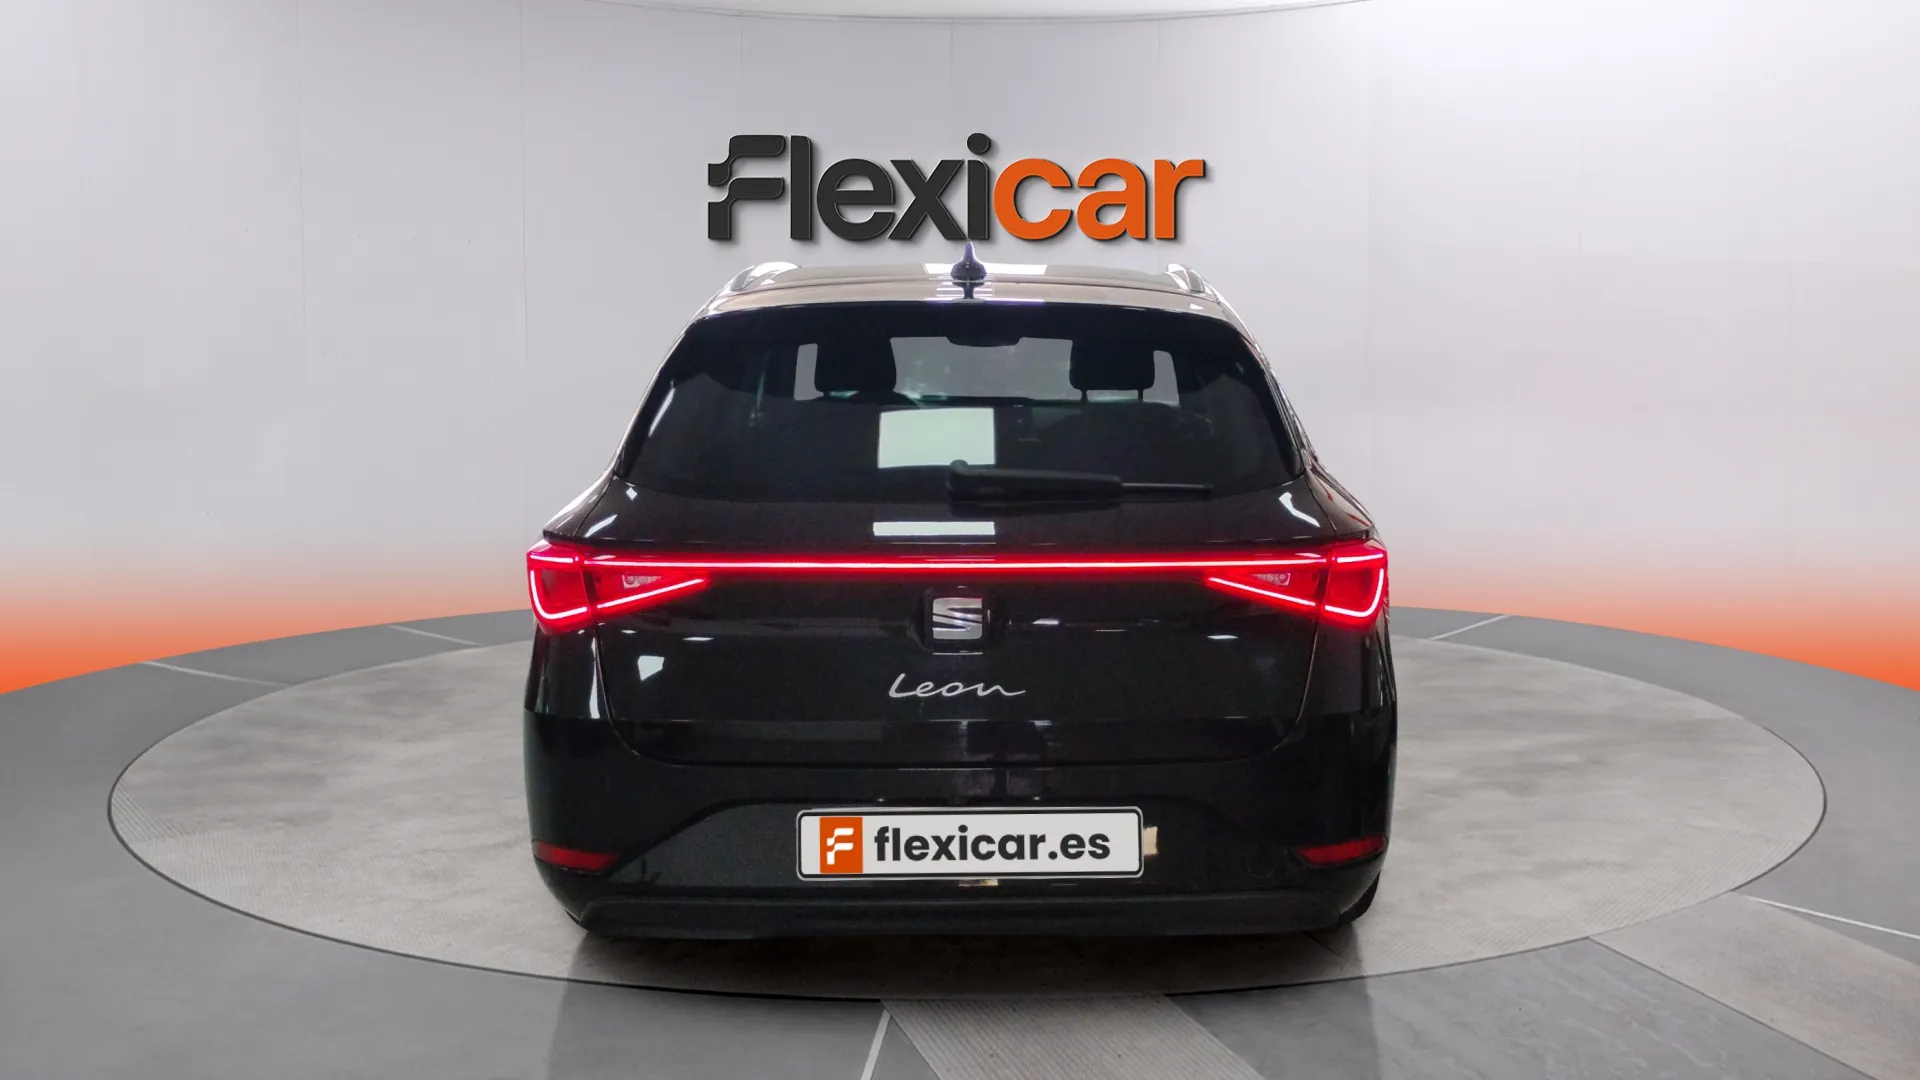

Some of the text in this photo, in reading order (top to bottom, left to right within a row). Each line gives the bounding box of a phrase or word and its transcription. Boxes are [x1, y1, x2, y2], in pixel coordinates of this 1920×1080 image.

[708, 132, 1206, 241] Flexicar
[889, 673, 1026, 698] Leon
[874, 825, 1111, 861] flexicar.es
